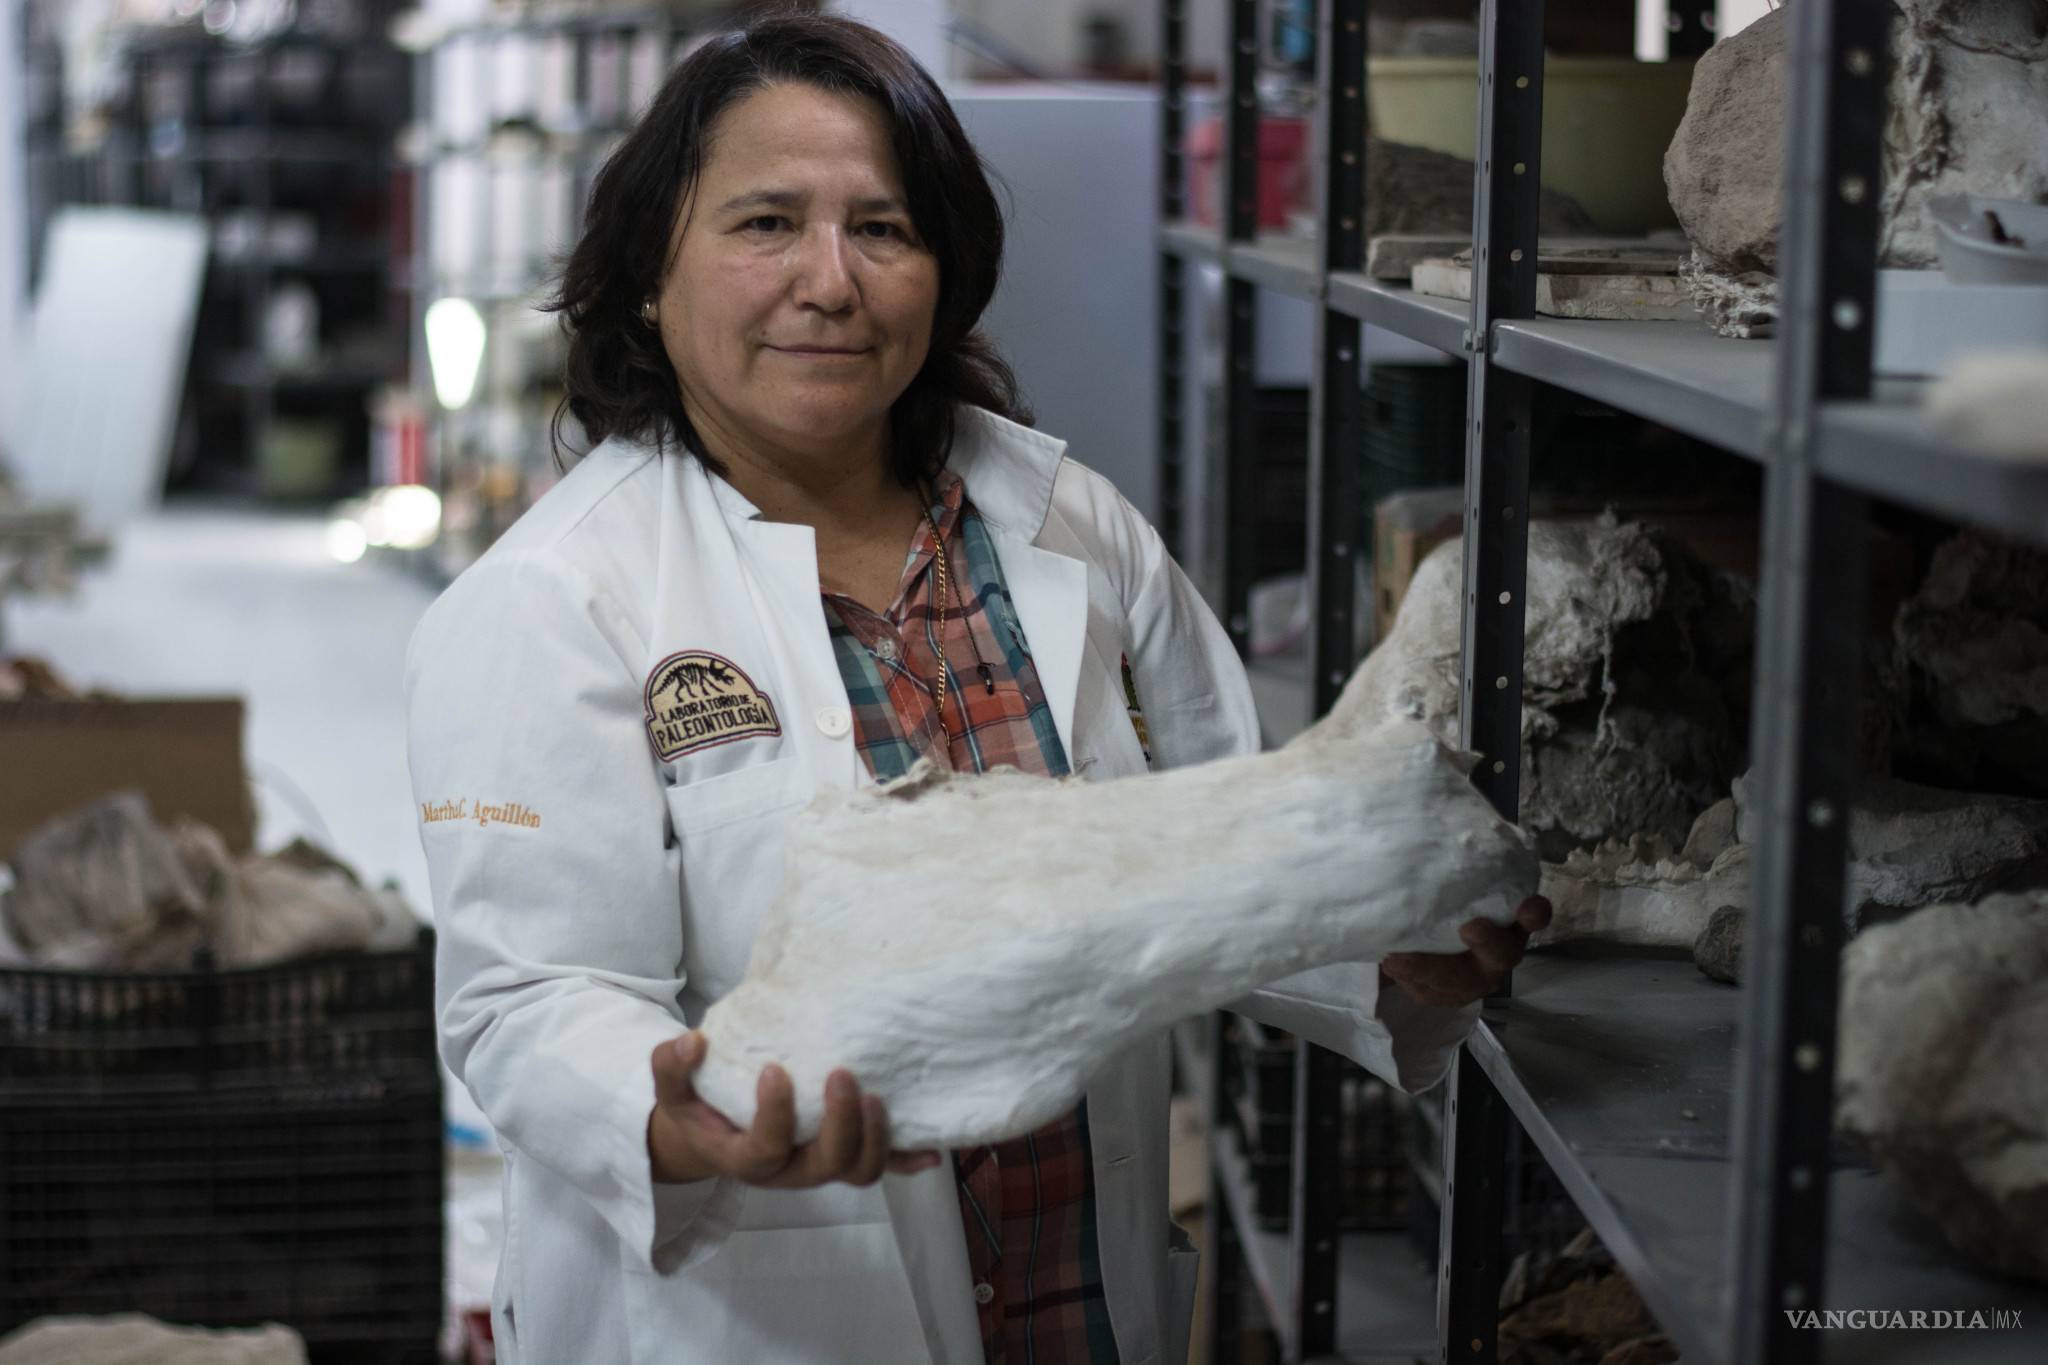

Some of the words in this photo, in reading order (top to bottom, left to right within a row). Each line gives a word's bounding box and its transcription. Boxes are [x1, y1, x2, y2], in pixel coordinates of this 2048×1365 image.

[660, 695, 740, 724] LABORATORIO
[740, 694, 752, 705] DE
[655, 703, 770, 749] PALEONTOLOGÍA
[471, 798, 541, 828] Aguillón
